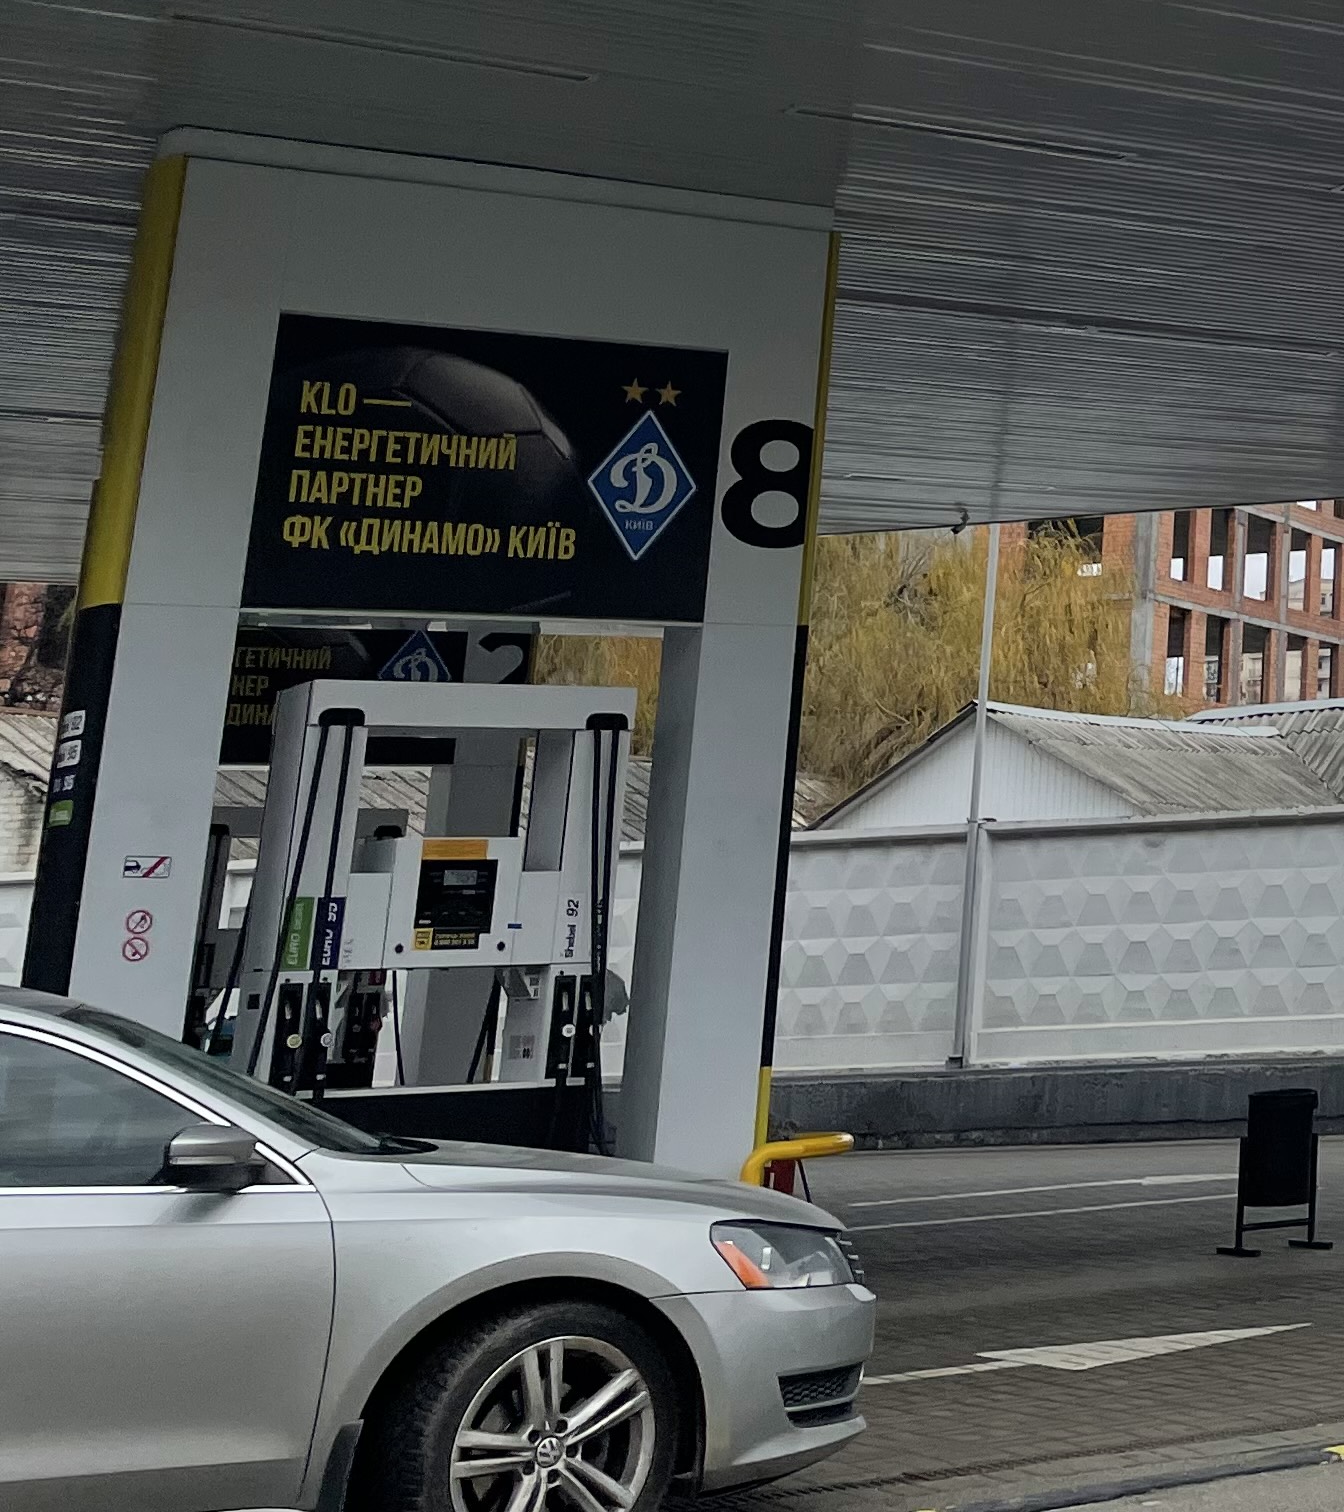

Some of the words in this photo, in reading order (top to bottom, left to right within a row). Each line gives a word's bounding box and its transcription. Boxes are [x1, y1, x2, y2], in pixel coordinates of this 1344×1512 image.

[300, 380, 357, 416] KLO
[295, 425, 518, 470] ЕНЕРГЕТИЧНИЙ
[288, 469, 423, 508] ПАРТНЕР
[721, 419, 815, 549] 8
[283, 514, 333, 550] ФК
[340, 518, 500, 556] «ДИНАМО»
[507, 521, 577, 560] КИЇВ
[234, 645, 332, 670] ГЕТИЧНИЙ
[566, 899, 579, 917] 92
